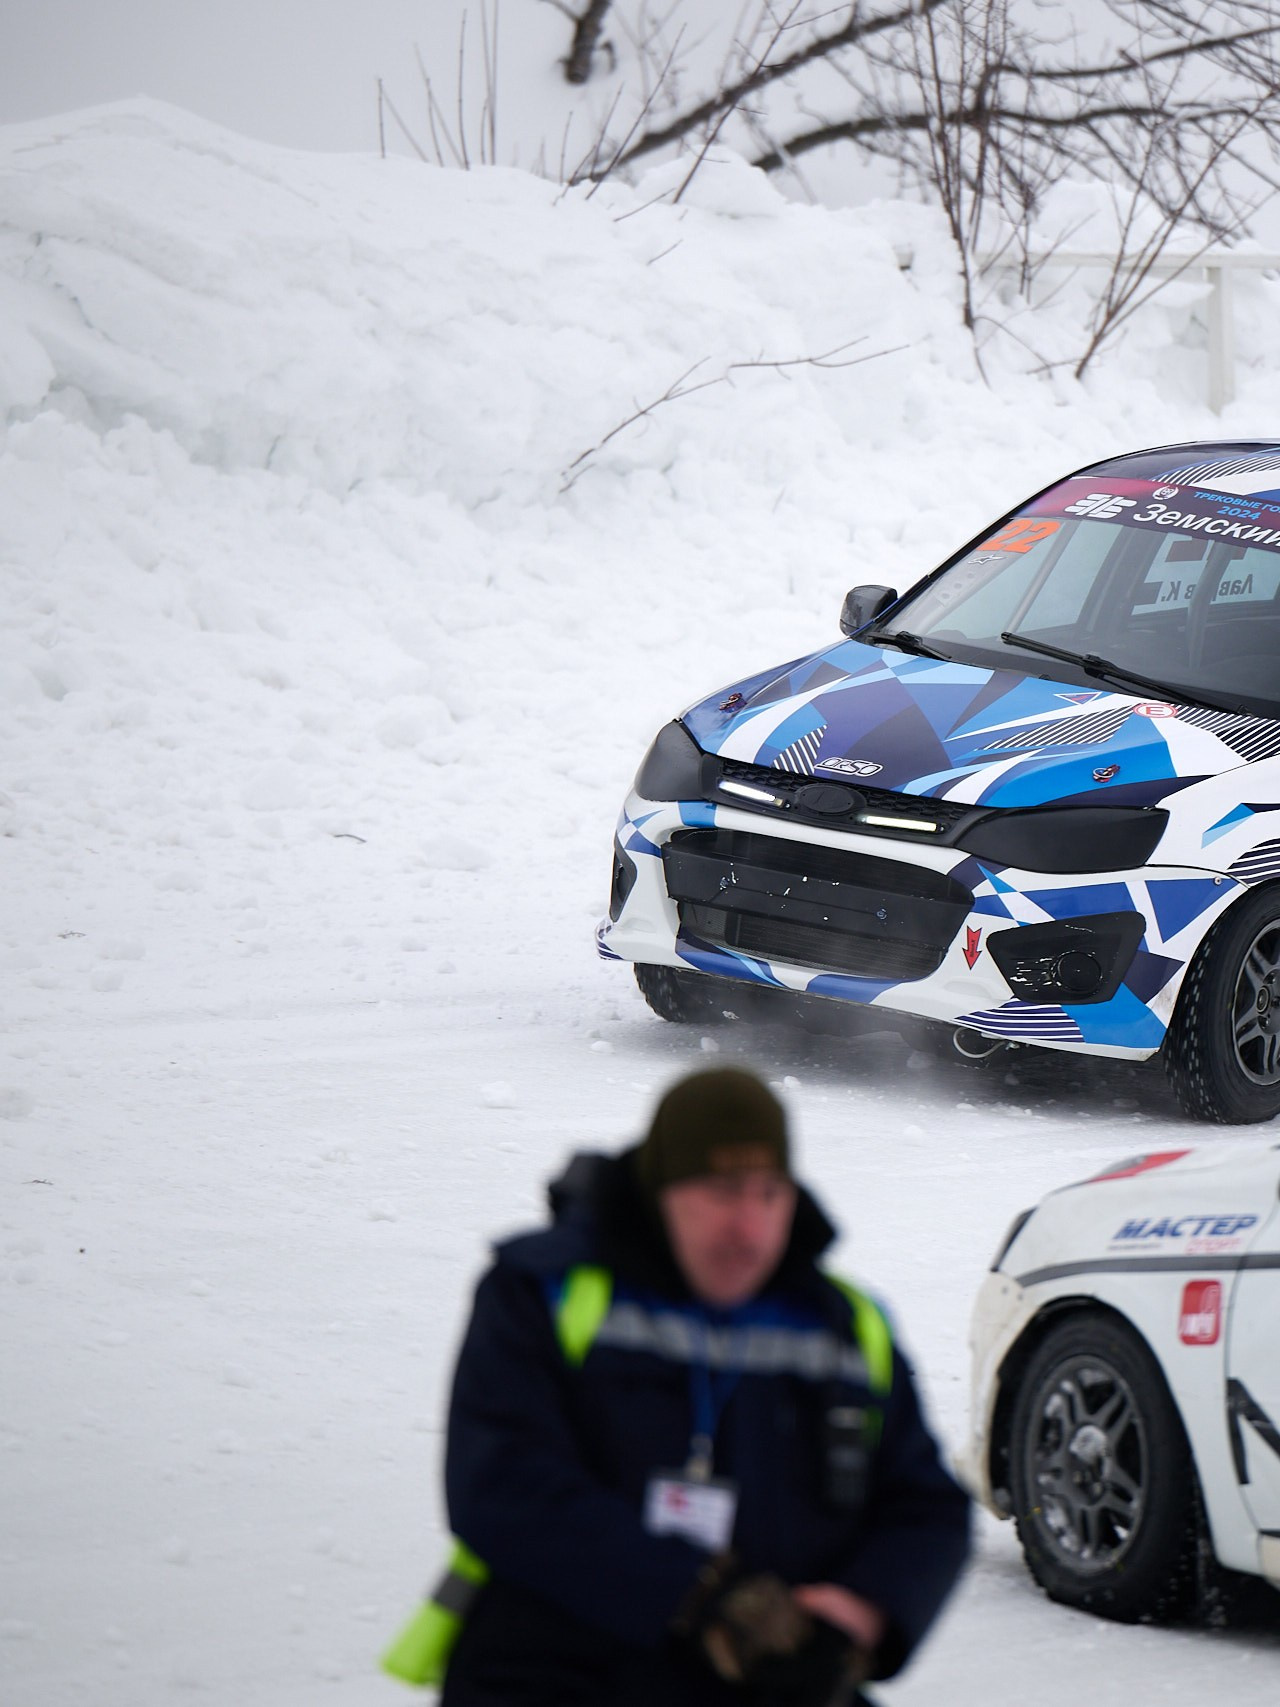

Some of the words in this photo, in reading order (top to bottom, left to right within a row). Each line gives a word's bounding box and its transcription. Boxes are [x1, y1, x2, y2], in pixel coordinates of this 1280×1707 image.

[1193, 491, 1260, 509] ТРЕКОВЫЕ
[1216, 505, 1262, 520] 2024
[975, 518, 1061, 555] 22
[1112, 1213, 1260, 1240] МАСТЕР
